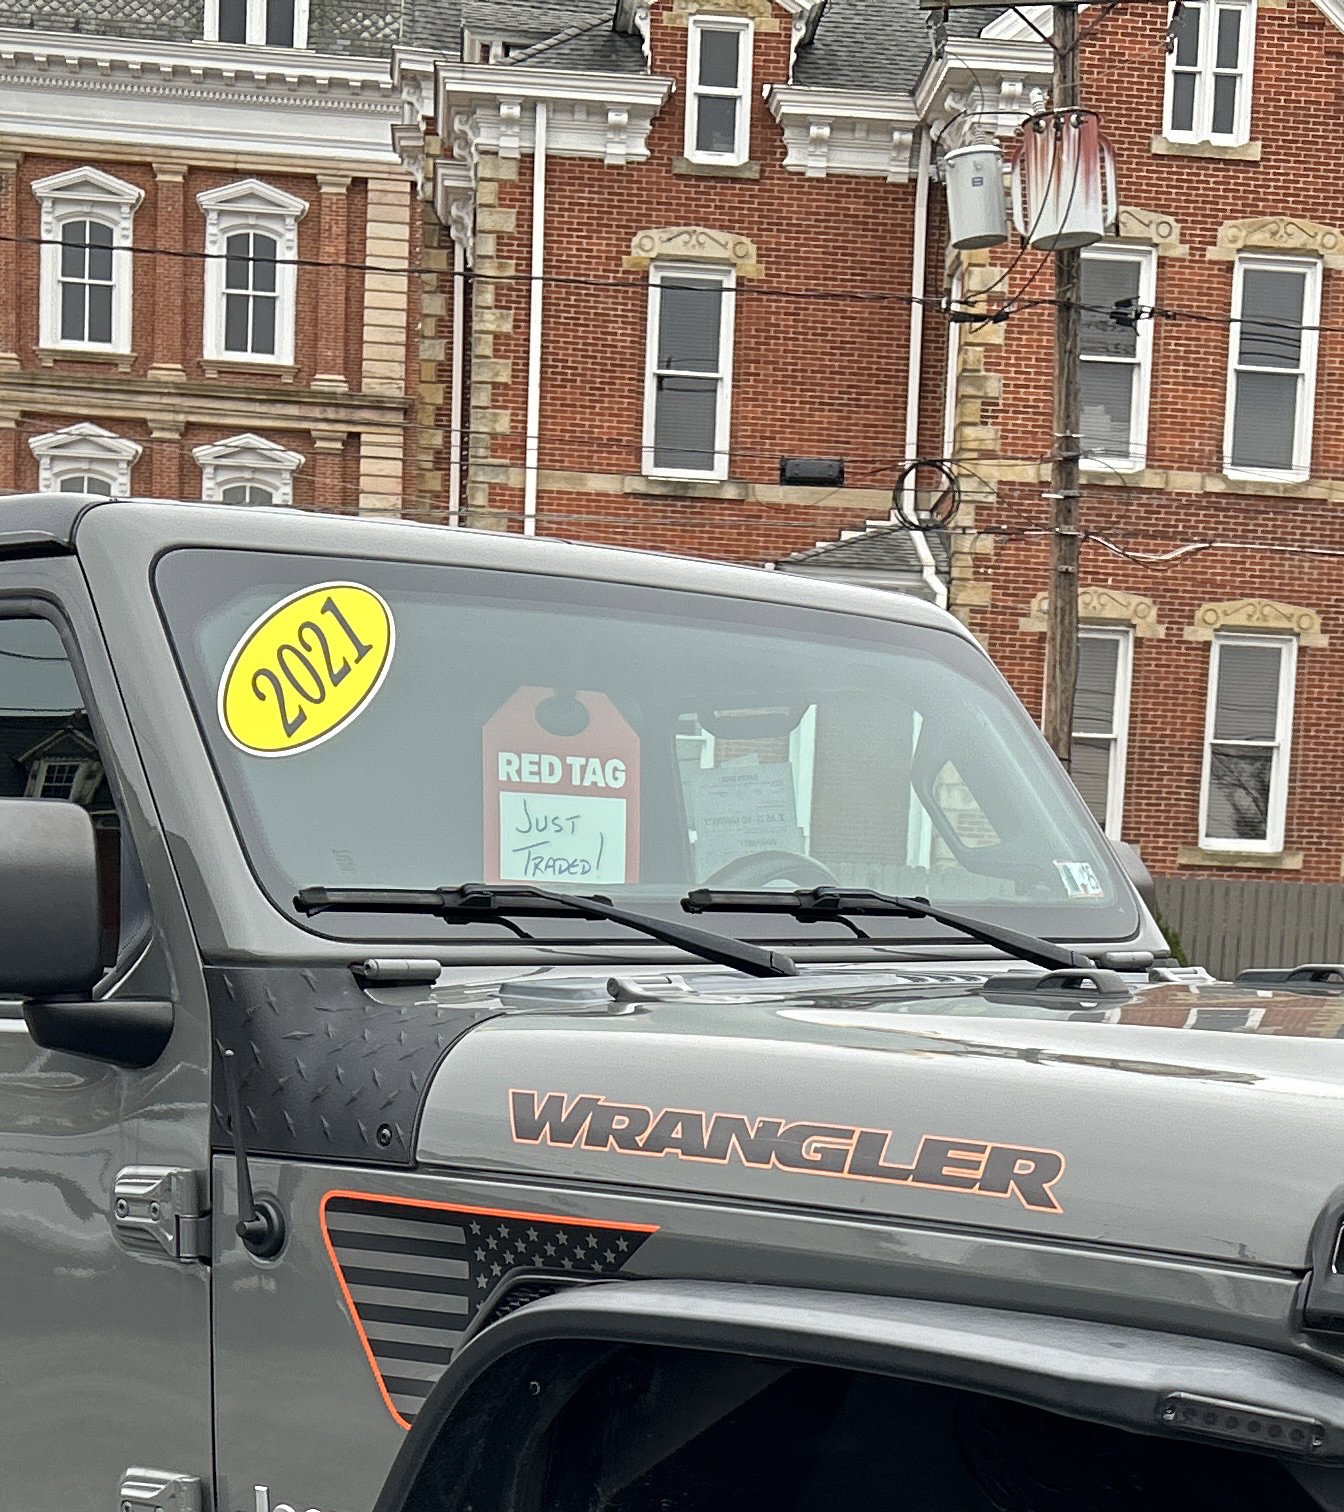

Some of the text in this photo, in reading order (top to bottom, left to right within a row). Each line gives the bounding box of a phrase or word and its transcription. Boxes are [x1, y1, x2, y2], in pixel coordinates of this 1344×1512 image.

[251, 596, 374, 738] 2021
[498, 751, 627, 789] RED TAG
[514, 798, 581, 834] JUST
[508, 1088, 1066, 1213] WRANGLER
